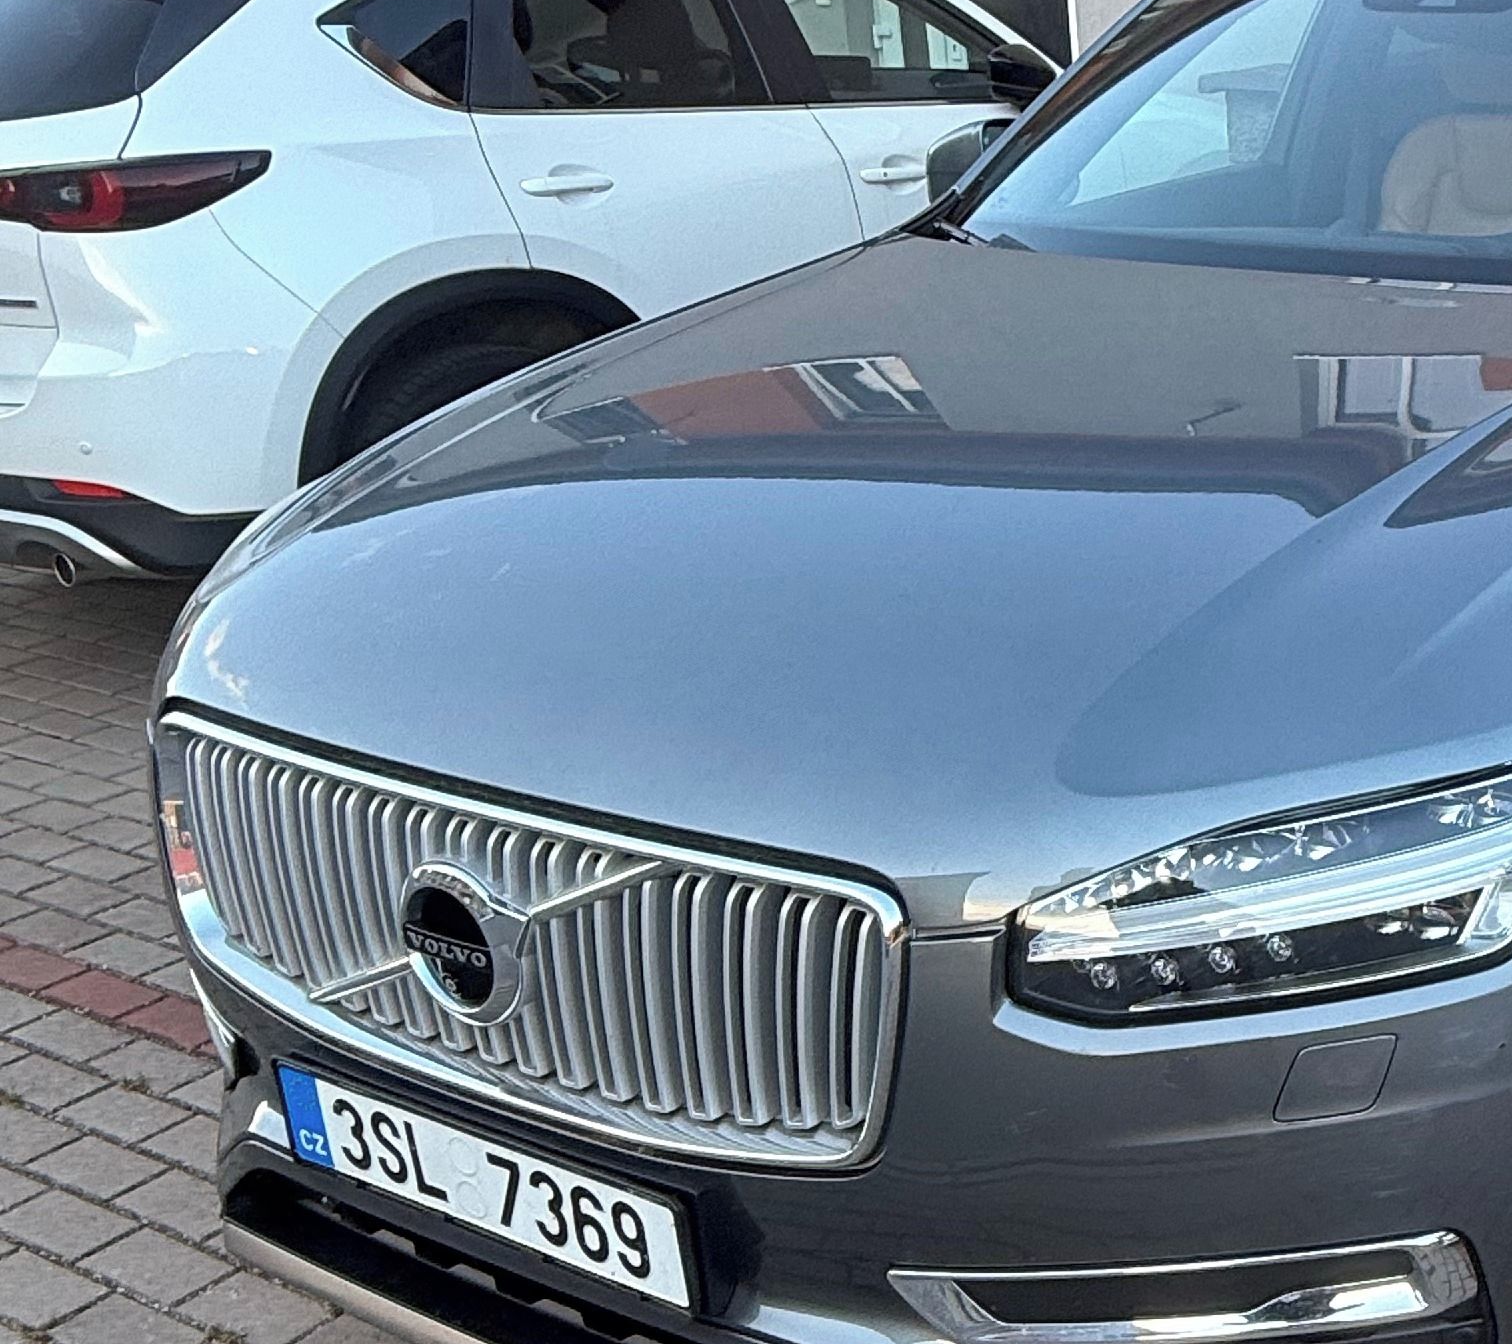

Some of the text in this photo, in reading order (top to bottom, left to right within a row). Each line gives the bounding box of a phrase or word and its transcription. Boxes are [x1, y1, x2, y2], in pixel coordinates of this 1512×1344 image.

[406, 930, 488, 968] VOLVO
[299, 1127, 329, 1158] CZ
[332, 1098, 651, 1279] 3SL 7369
